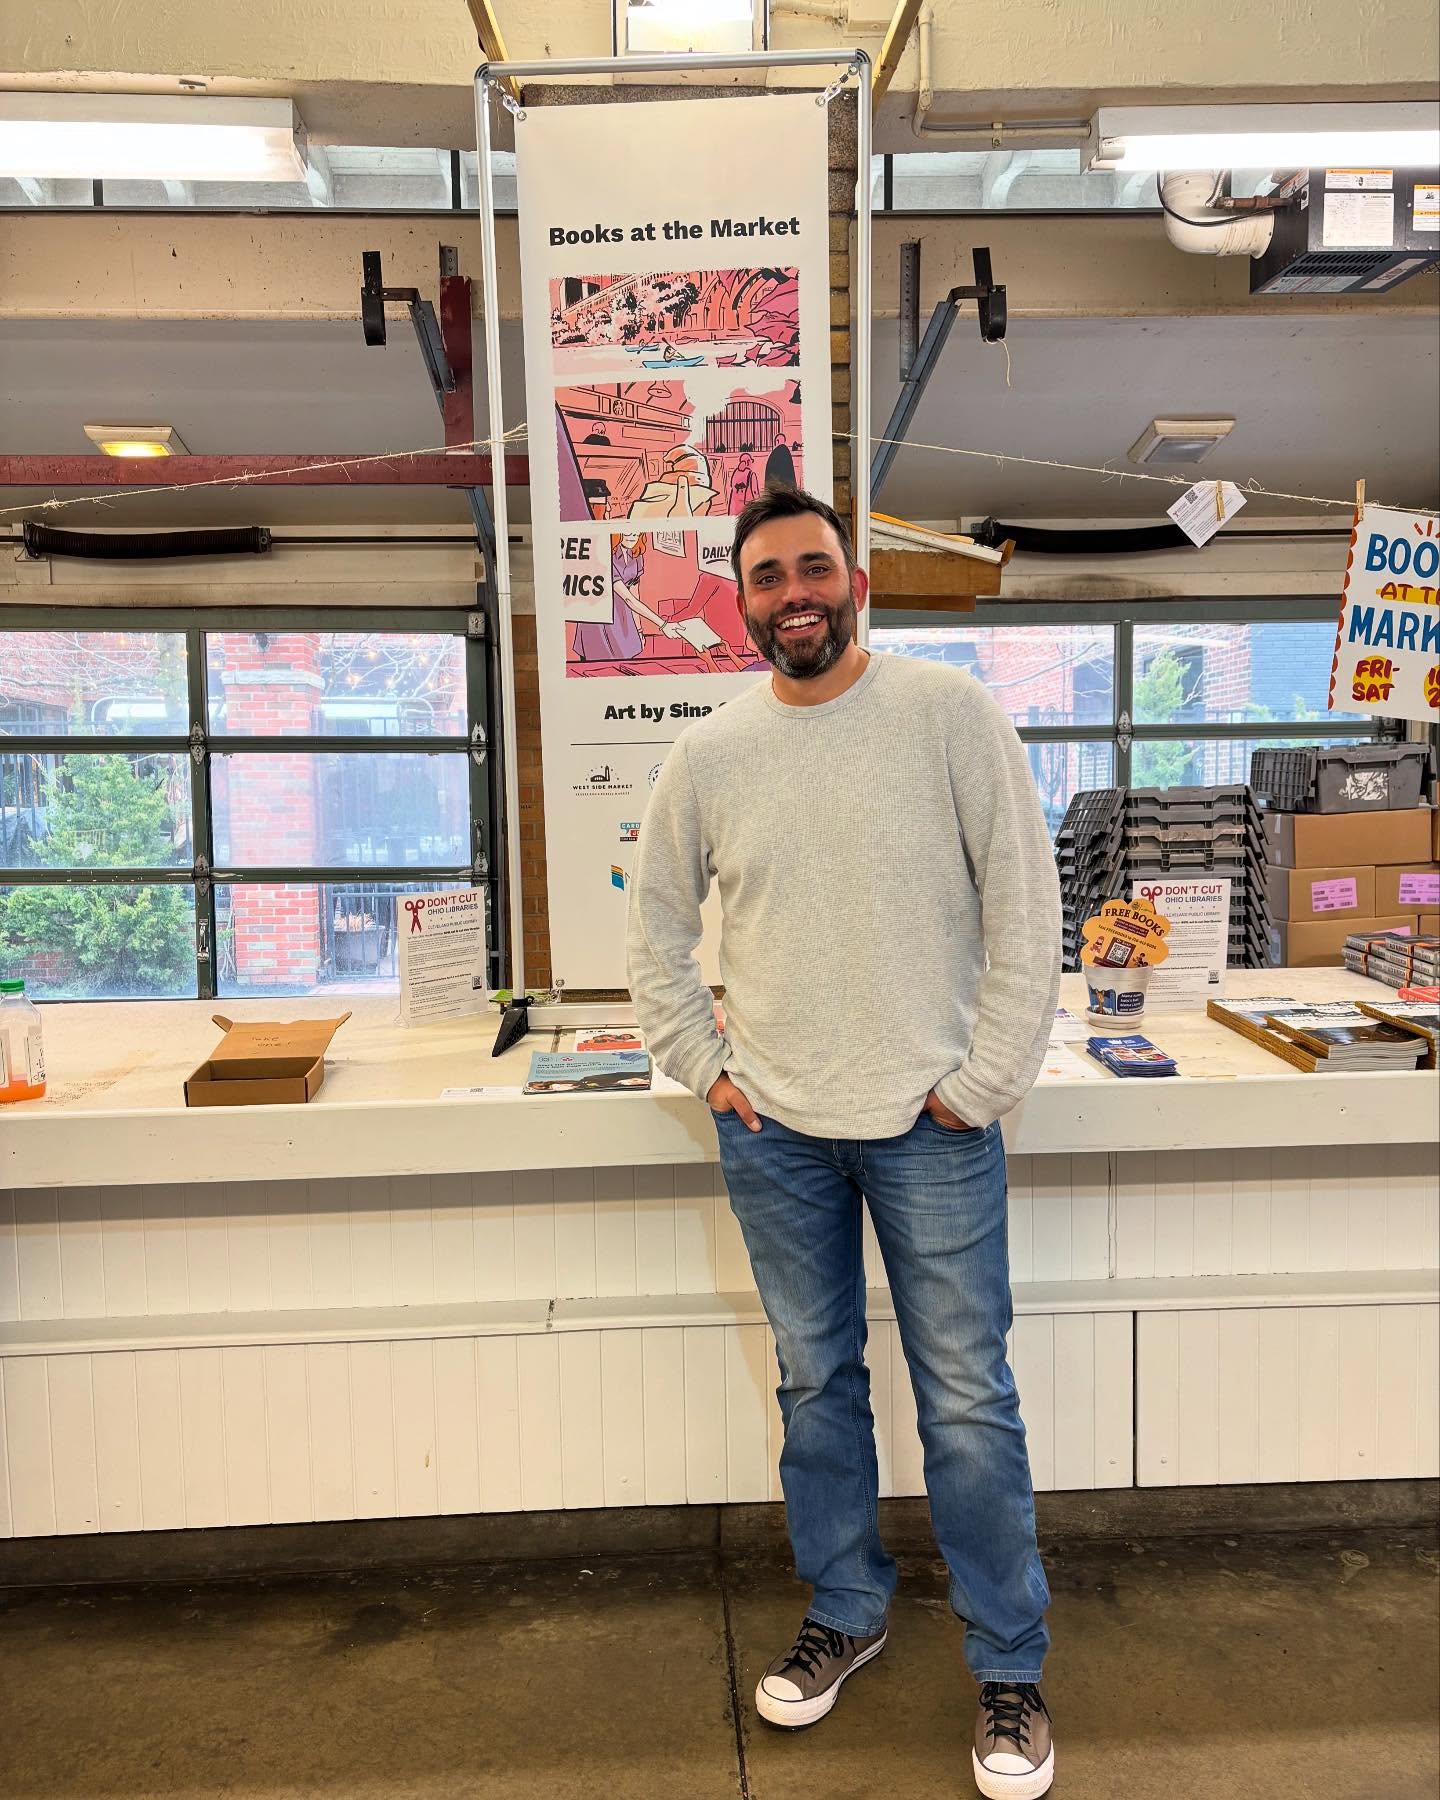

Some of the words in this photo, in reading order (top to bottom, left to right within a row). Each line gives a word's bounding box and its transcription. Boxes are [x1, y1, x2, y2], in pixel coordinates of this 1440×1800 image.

[549, 223, 624, 246] Books
[630, 222, 656, 241] at
[662, 220, 703, 240] the
[711, 216, 800, 238] Market
[702, 546, 732, 559] DAILY
[1380, 581, 1413, 601] AT
[1420, 586, 1440, 605] T
[1352, 682, 1395, 702] SAT
[604, 705, 636, 720] Art
[641, 703, 665, 722] by
[670, 701, 713, 718] Sina
[1165, 886, 1198, 895] DON'T
[1201, 885, 1223, 894] CUT
[428, 896, 456, 907] DON'T
[459, 893, 477, 904] CUT
[1185, 895, 1223, 903] LIBRARIES
[446, 903, 479, 913] LIBRARIES
[1105, 908, 1131, 917] FREE
[1132, 911, 1165, 937] BOOKS
